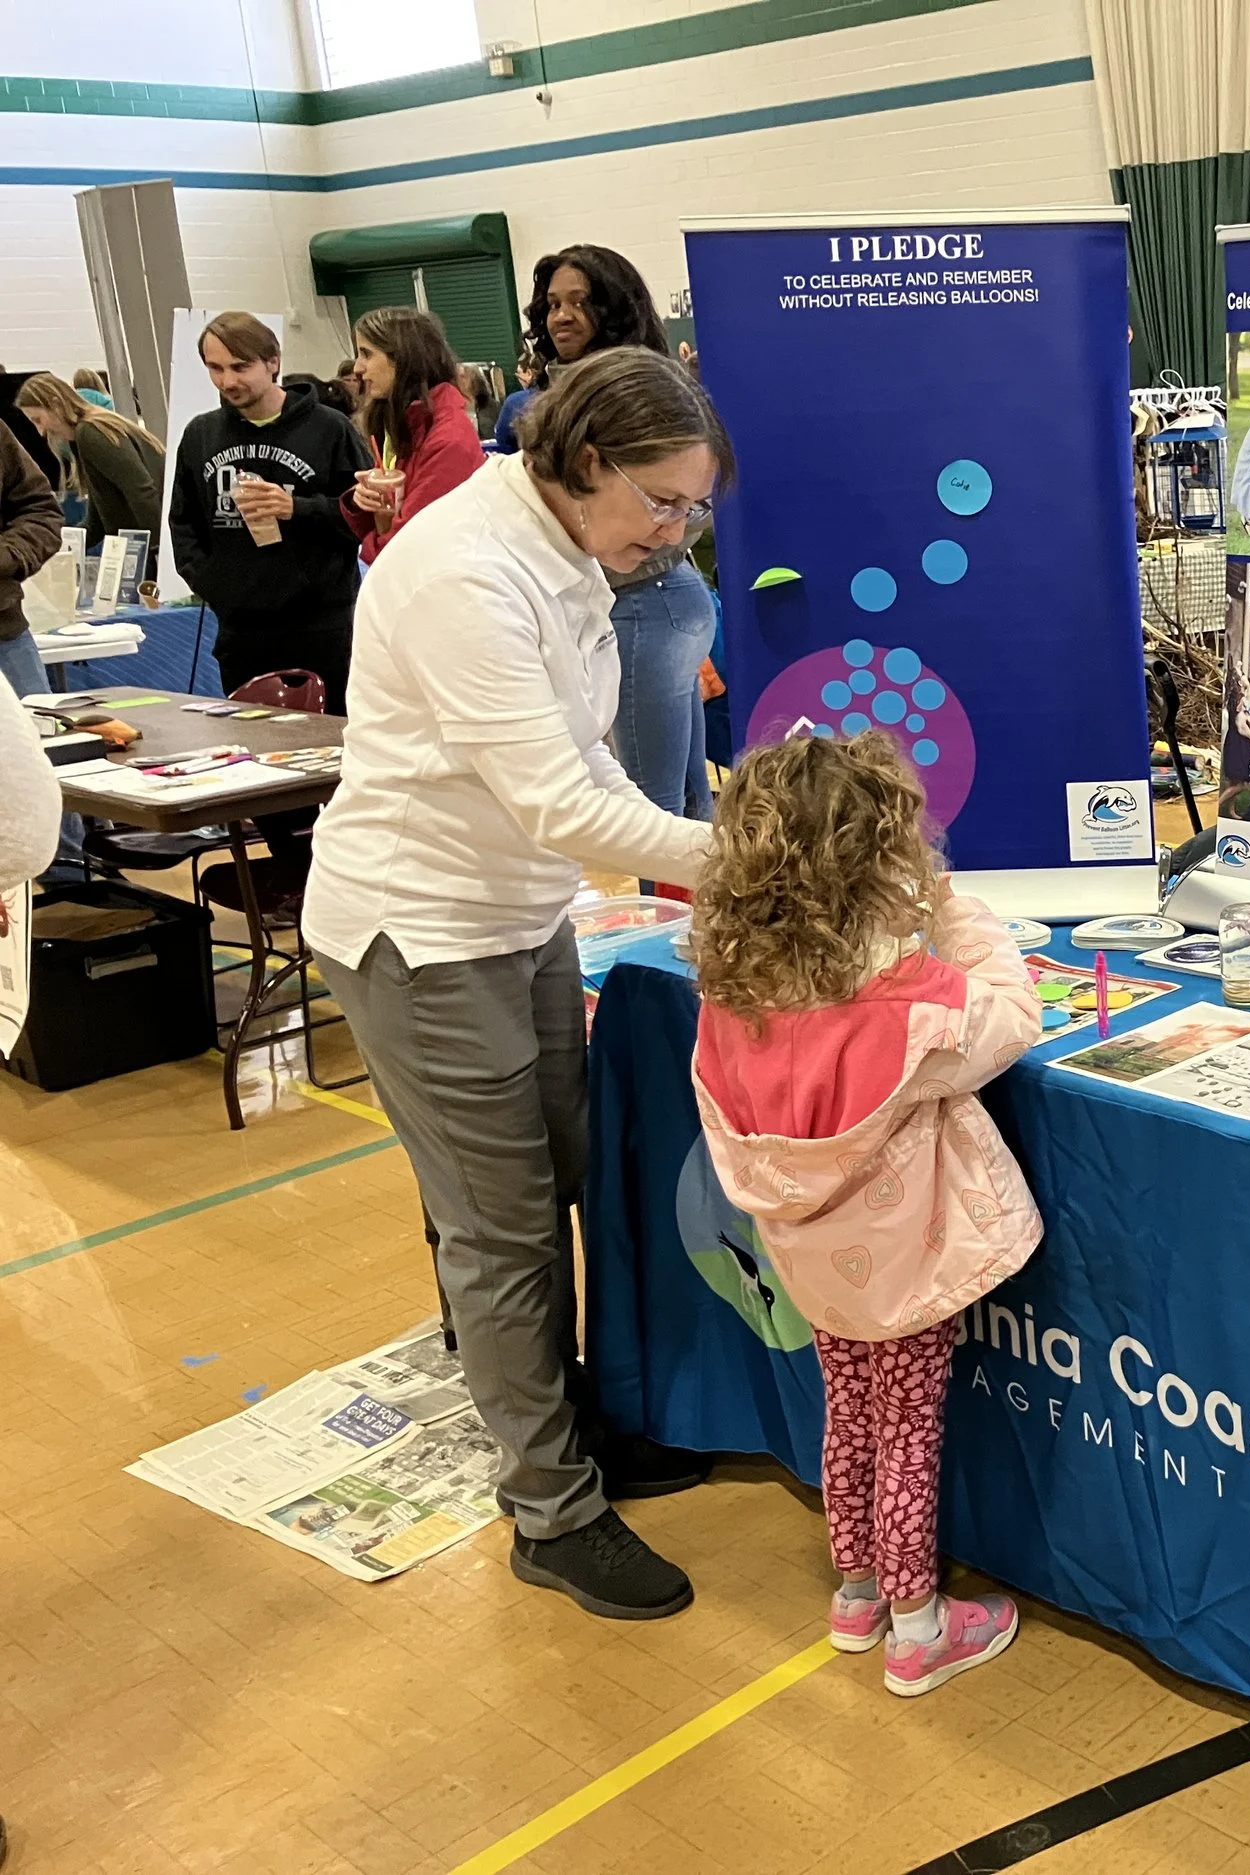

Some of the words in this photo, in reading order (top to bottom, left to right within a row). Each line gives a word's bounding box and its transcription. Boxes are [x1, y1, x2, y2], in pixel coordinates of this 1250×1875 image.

[829, 237, 840, 262] I
[851, 234, 984, 261] PLEDGE
[784, 276, 805, 290] TO
[810, 273, 902, 289] CELEBRATE
[906, 272, 939, 286] AND
[943, 270, 1033, 284] REMEMBER
[780, 293, 853, 310] WITHOUT
[857, 290, 947, 307] RELEASING
[951, 288, 1039, 304] BALLOONS!
[347, 1406, 376, 1425] GREAT
[371, 1419, 397, 1436] DAYS
[361, 1398, 380, 1412] GET
[378, 1406, 402, 1425] FOUR
